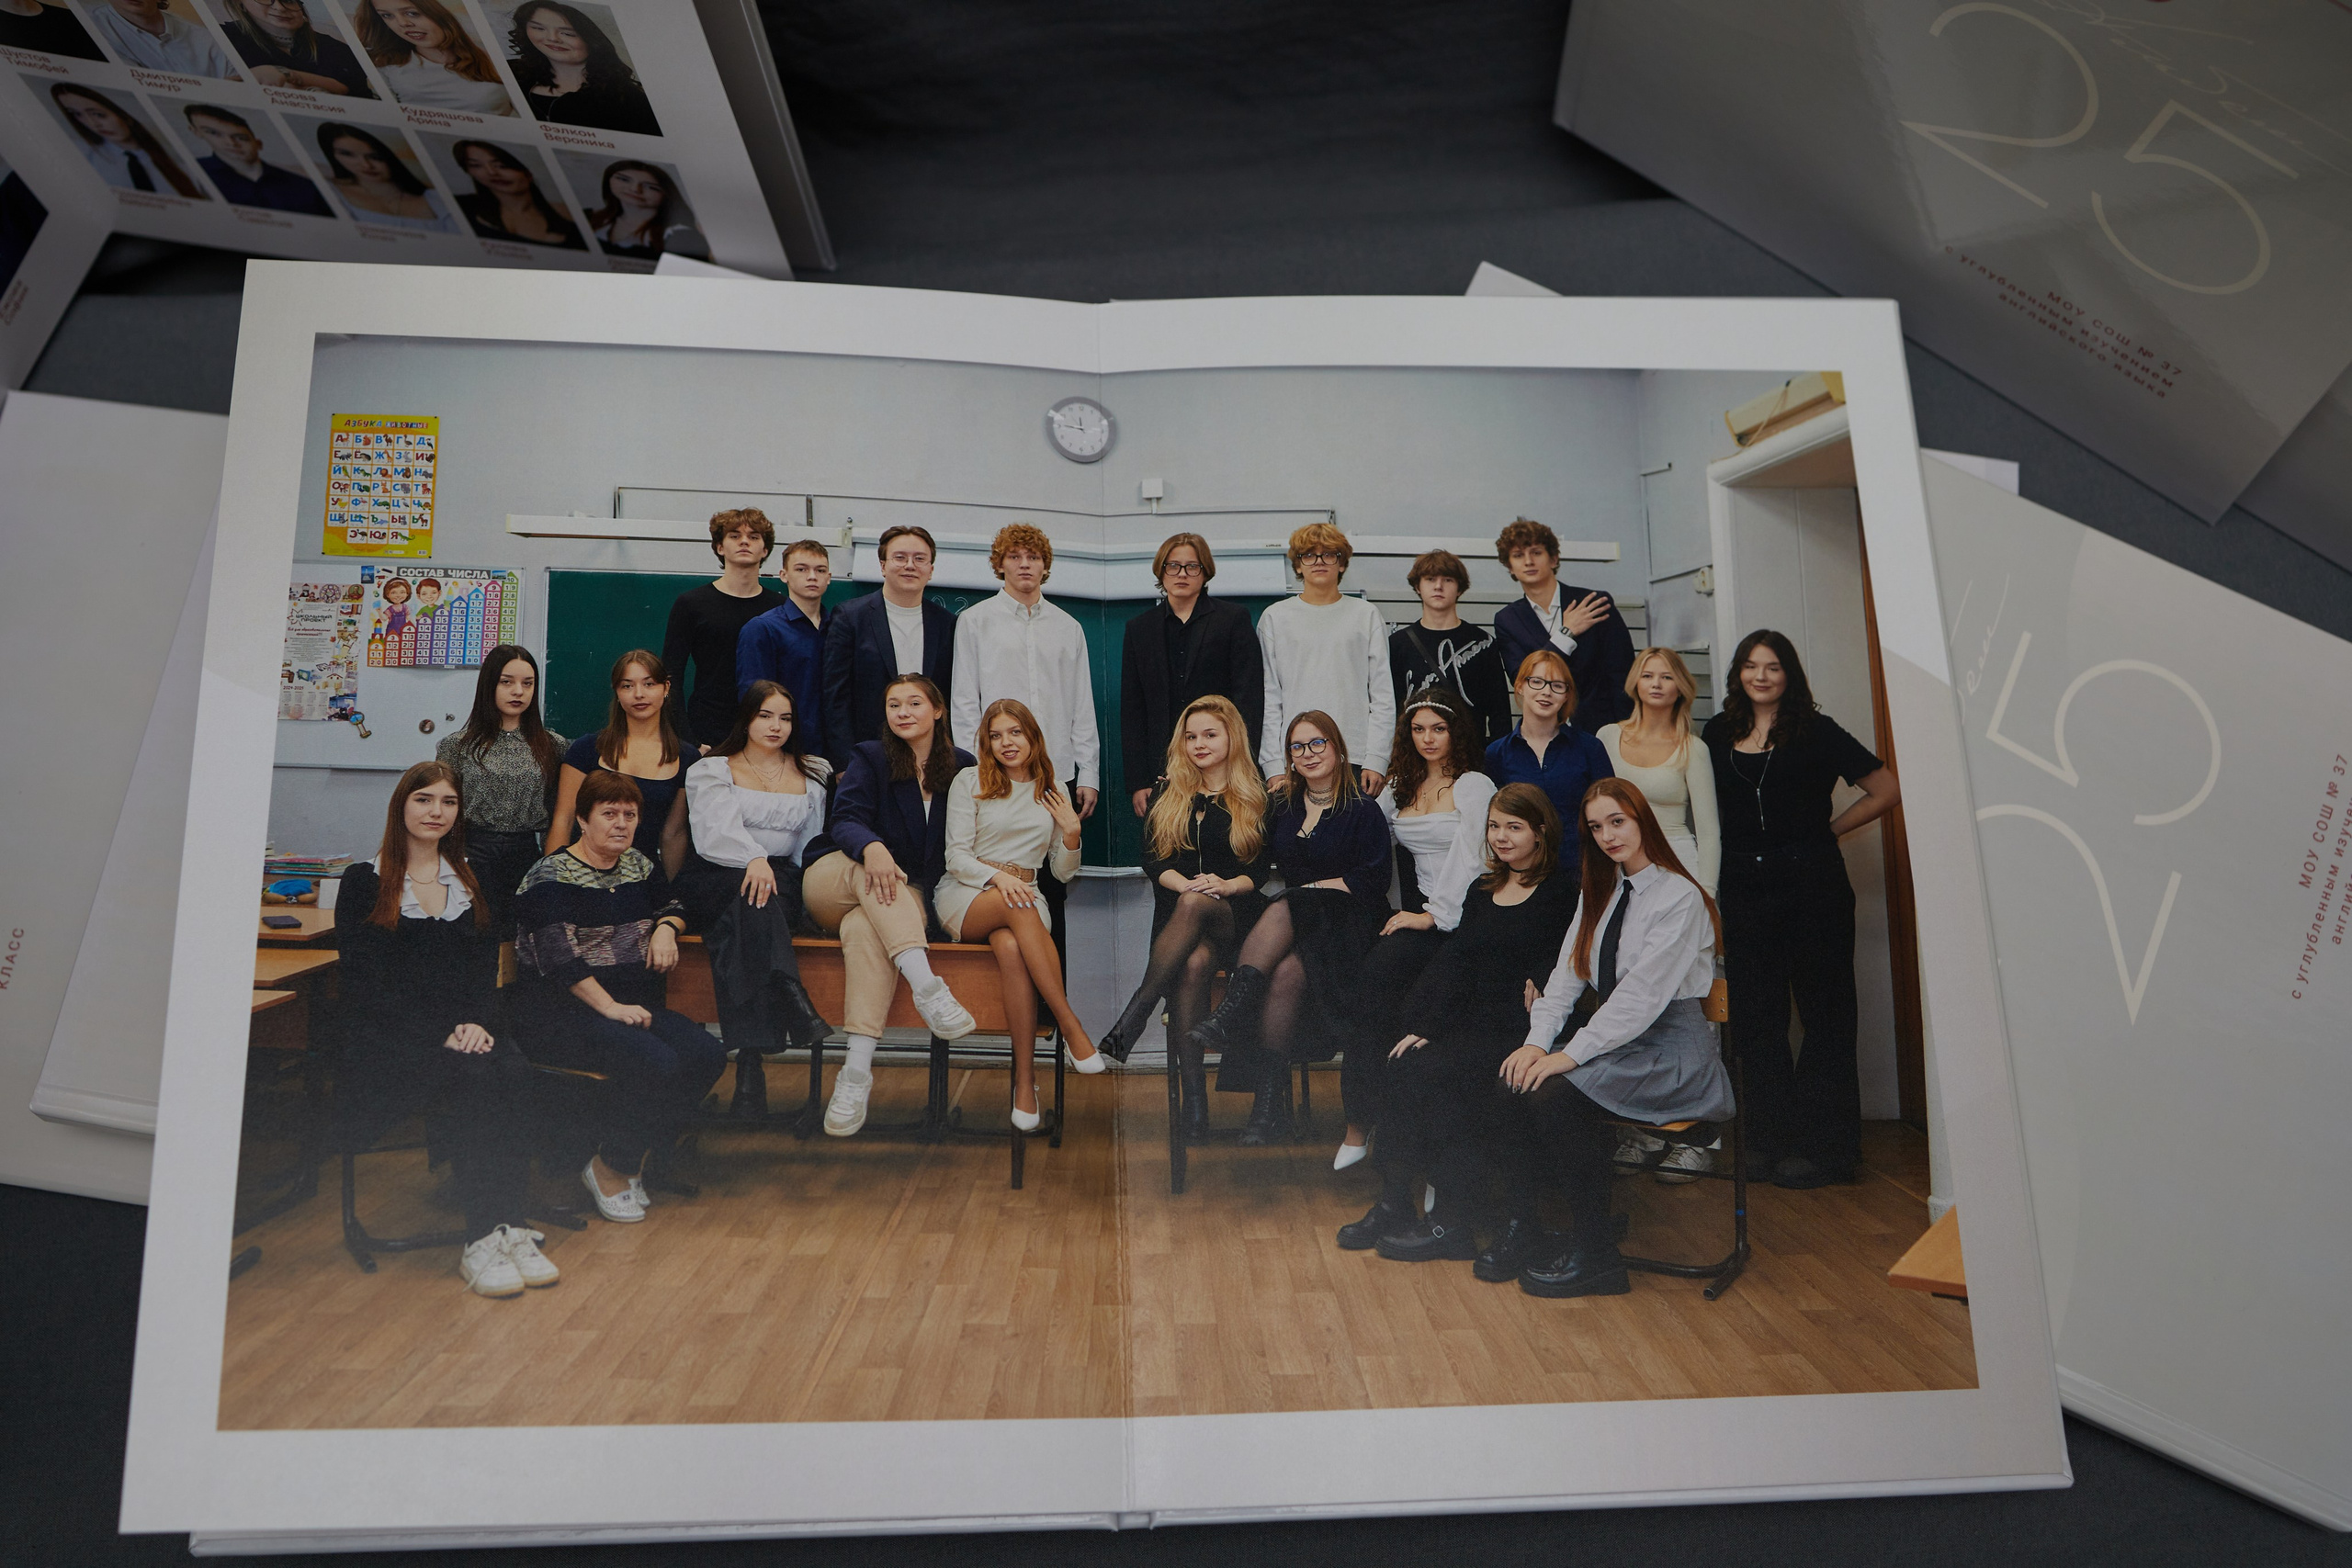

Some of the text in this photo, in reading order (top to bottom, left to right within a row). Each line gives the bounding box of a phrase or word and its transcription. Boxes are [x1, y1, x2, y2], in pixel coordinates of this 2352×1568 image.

[4, 56, 69, 73] Тимофей
[130, 69, 202, 86] Дмитриев
[134, 78, 181, 92] Тимур
[263, 88, 317, 102] Серова
[271, 97, 346, 114] Анастасия
[400, 106, 484, 124] Кудряшова
[407, 115, 452, 127] Арина
[539, 124, 597, 139] Фэлкон
[544, 133, 616, 149] Вероника
[1960, 254, 2074, 327] углубленным
[2080, 328, 2174, 389] изучением
[2047, 291, 2086, 316] МОУ
[2092, 318, 2132, 346] СОШ
[2160, 360, 2183, 377] 37
[1998, 292, 2166, 399] английского языка
[333, 465, 341, 474] Й
[392, 499, 400, 508] Ц
[400, 568, 489, 579] СОСТАВ ЧИСЛА
[2298, 753, 2348, 889] МОУ СОШ № 37
[2331, 874, 2352, 945] англий
[2296, 864, 2340, 985] углубленным
[0, 927, 25, 990] КЛАСС
[2292, 990, 2302, 1000] с
